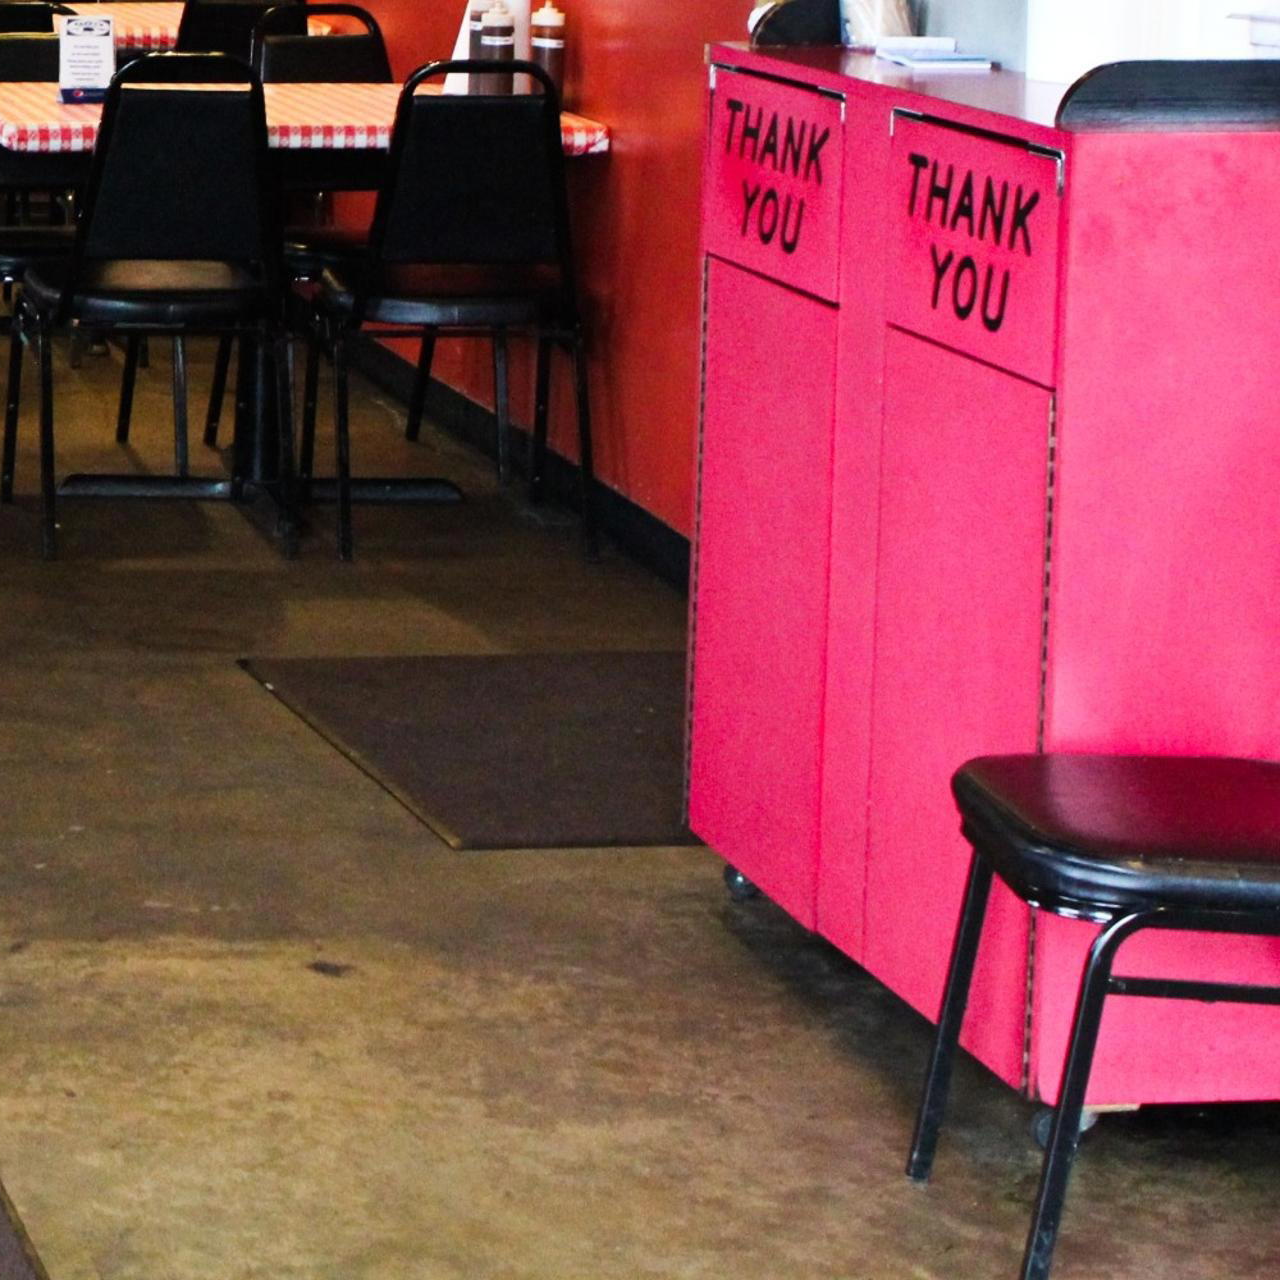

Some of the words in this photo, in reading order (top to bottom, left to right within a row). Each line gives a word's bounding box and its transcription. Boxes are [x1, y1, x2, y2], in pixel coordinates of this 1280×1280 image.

[726, 98, 831, 186] THANK
[740, 178, 805, 255] YOU
[907, 152, 1040, 257] THANK
[930, 242, 1011, 333] YOU
